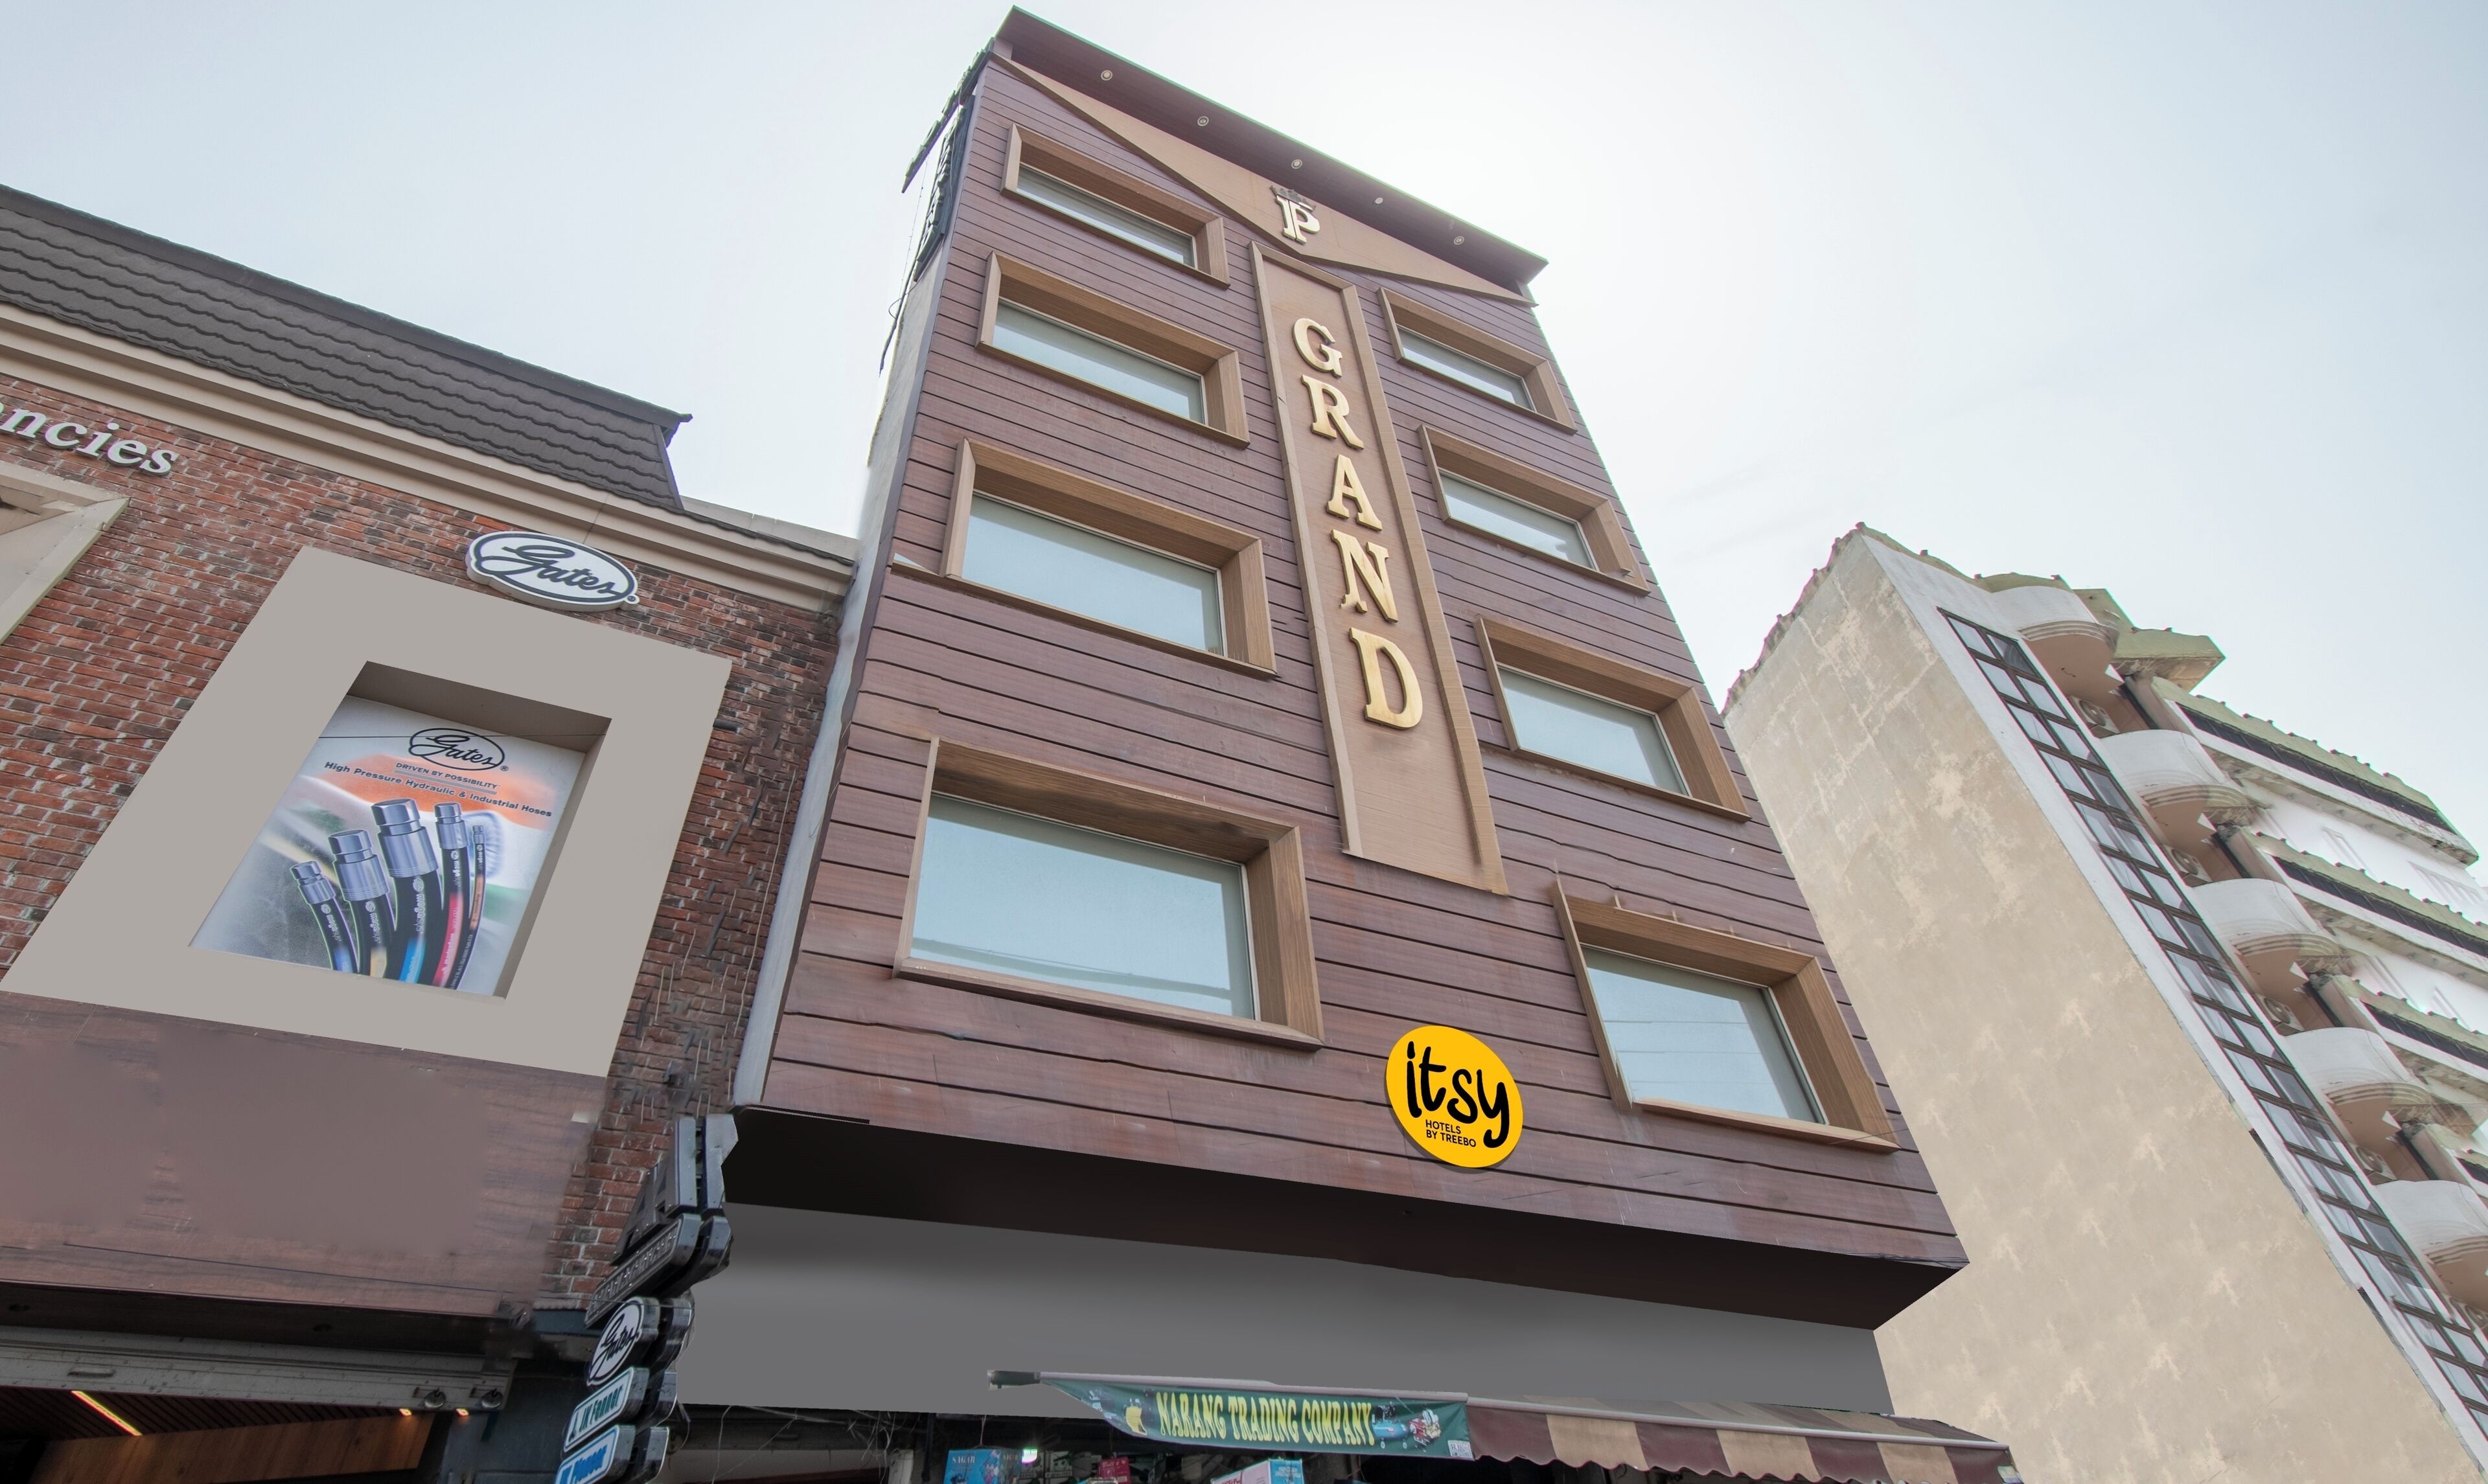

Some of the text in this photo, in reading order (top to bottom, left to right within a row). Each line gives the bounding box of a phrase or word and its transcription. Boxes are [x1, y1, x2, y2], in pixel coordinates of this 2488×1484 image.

[0, 401, 179, 475] ncies
[1291, 318, 1423, 730] GRAND
[477, 545, 623, 595] Gates
[396, 762, 430, 774] DRIVEN
[444, 773, 498, 790] POSSIBILITY
[409, 734, 498, 766] Gates
[324, 761, 351, 773] High
[353, 768, 402, 784] Pressure
[405, 779, 455, 795] Hydraulic
[470, 793, 519, 809] Industrial
[521, 804, 552, 817] Hoses
[1406, 1041, 1510, 1148] itsy
[1425, 1119, 1461, 1134] HOTELS
[1426, 1129, 1477, 1148] BY TREEBO
[1156, 1391, 1375, 1446] NARANG TRADING COMPANY
